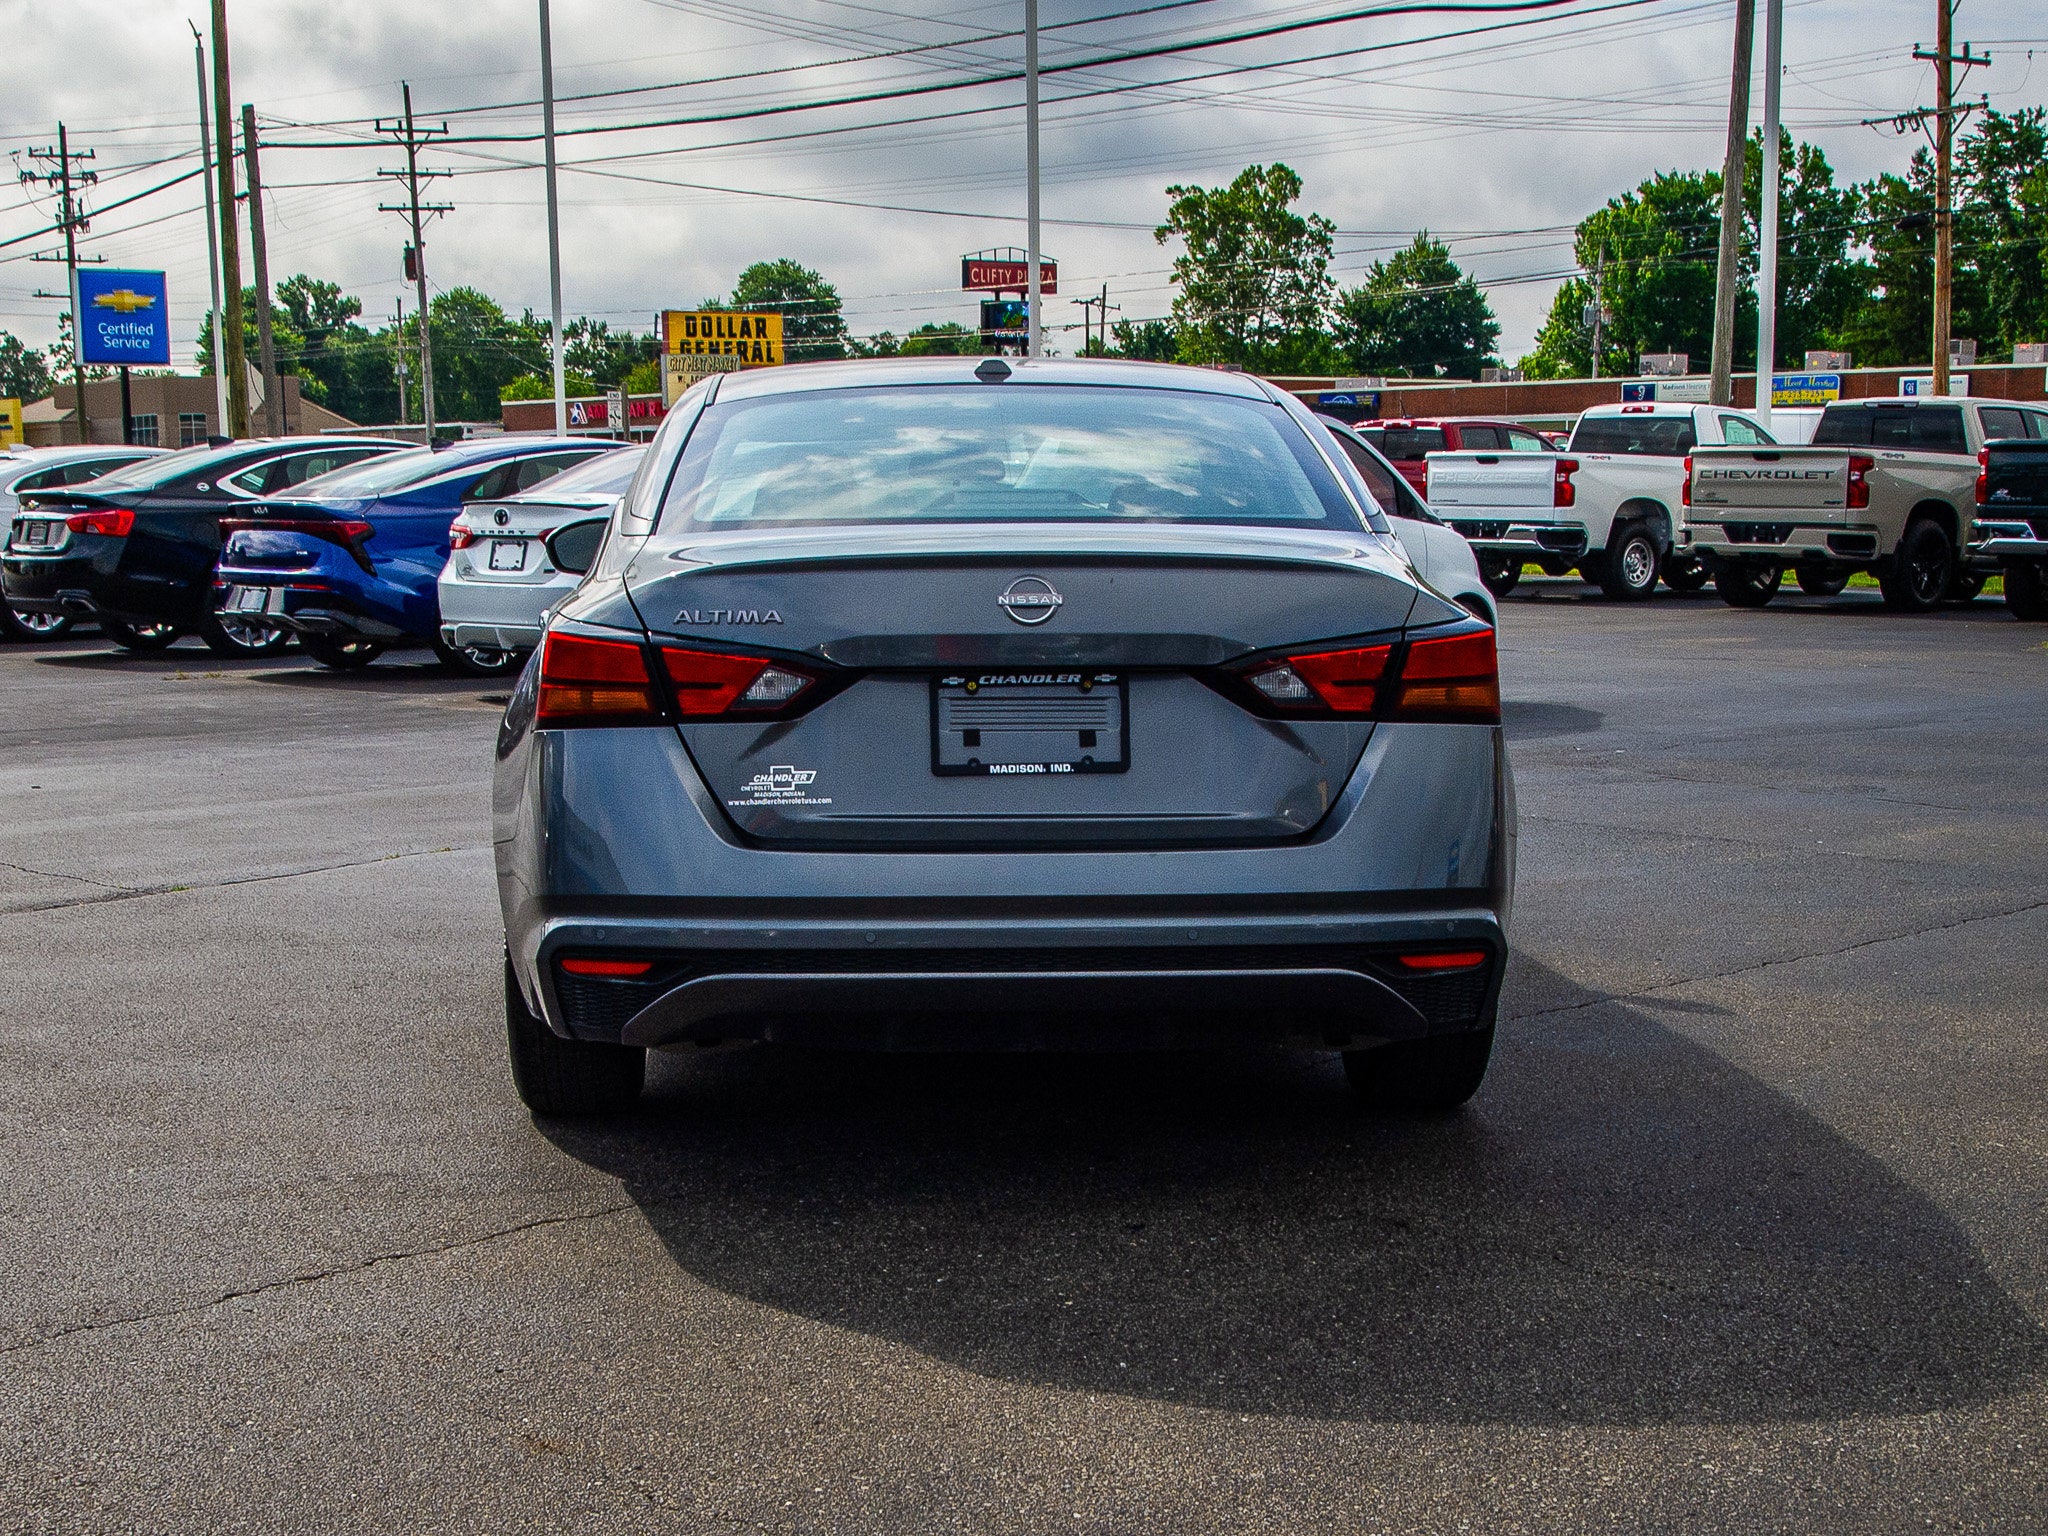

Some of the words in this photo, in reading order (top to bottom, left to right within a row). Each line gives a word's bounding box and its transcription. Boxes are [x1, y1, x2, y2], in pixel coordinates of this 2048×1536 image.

[971, 267, 1012, 283] CLIFTY
[1017, 269, 1053, 283] PLZA
[98, 322, 154, 336] Certified
[684, 315, 768, 338] DOLLAR
[103, 336, 150, 348] Service
[1700, 469, 1835, 480] CHEVROLET
[997, 595, 1063, 604] NISSAN
[672, 609, 785, 625] ALTIMA
[978, 674, 1082, 685] CHANDLER
[1050, 763, 1075, 773] IND.
[753, 773, 808, 783] CHANDLER
[727, 797, 833, 806] www.chandlerchevroletusa.com
